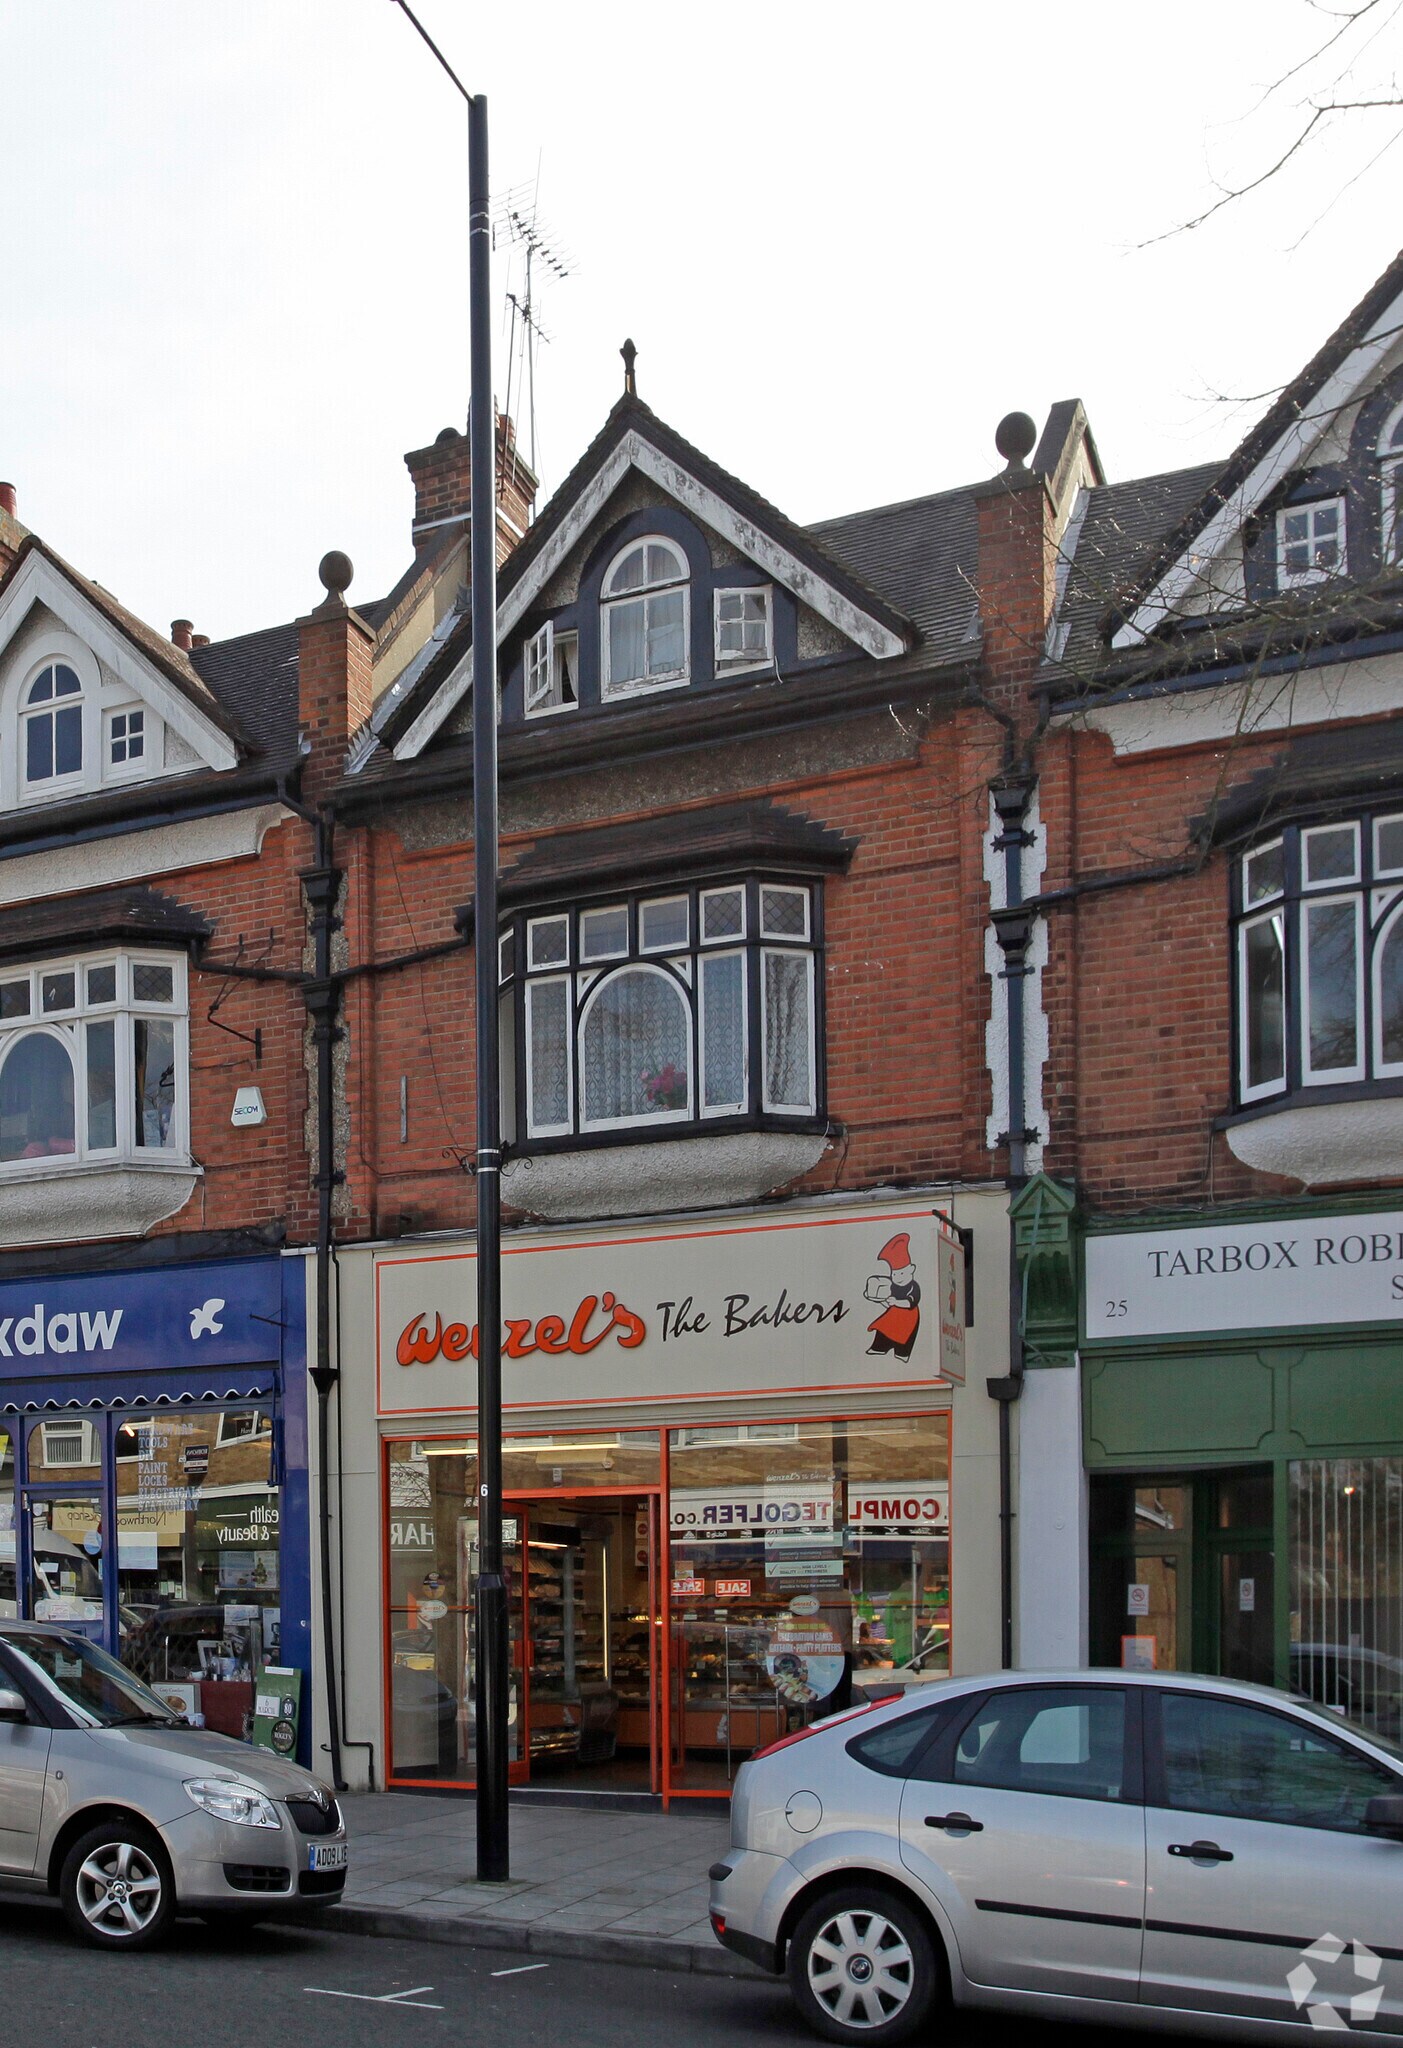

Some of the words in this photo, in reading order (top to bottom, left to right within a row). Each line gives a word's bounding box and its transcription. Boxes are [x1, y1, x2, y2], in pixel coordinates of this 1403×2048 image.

[234, 1105, 258, 1116] SECOM
[1148, 1240, 1299, 1278] TARBOX
[1105, 1299, 1128, 1318] 25
[396, 1291, 646, 1366] Wezel's
[656, 1296, 711, 1342] The
[723, 1288, 850, 1338] Bakers
[138, 1437, 168, 1449] TOOLS
[138, 1450, 156, 1461] DIY
[138, 1462, 168, 1474] PAINT
[138, 1475, 168, 1487] LOCKS
[138, 1486, 203, 1499] ELECTRICALS
[480, 1483, 488, 1497] 6
[138, 1499, 200, 1512] STATIONERY
[316, 1847, 336, 1867] AD09
